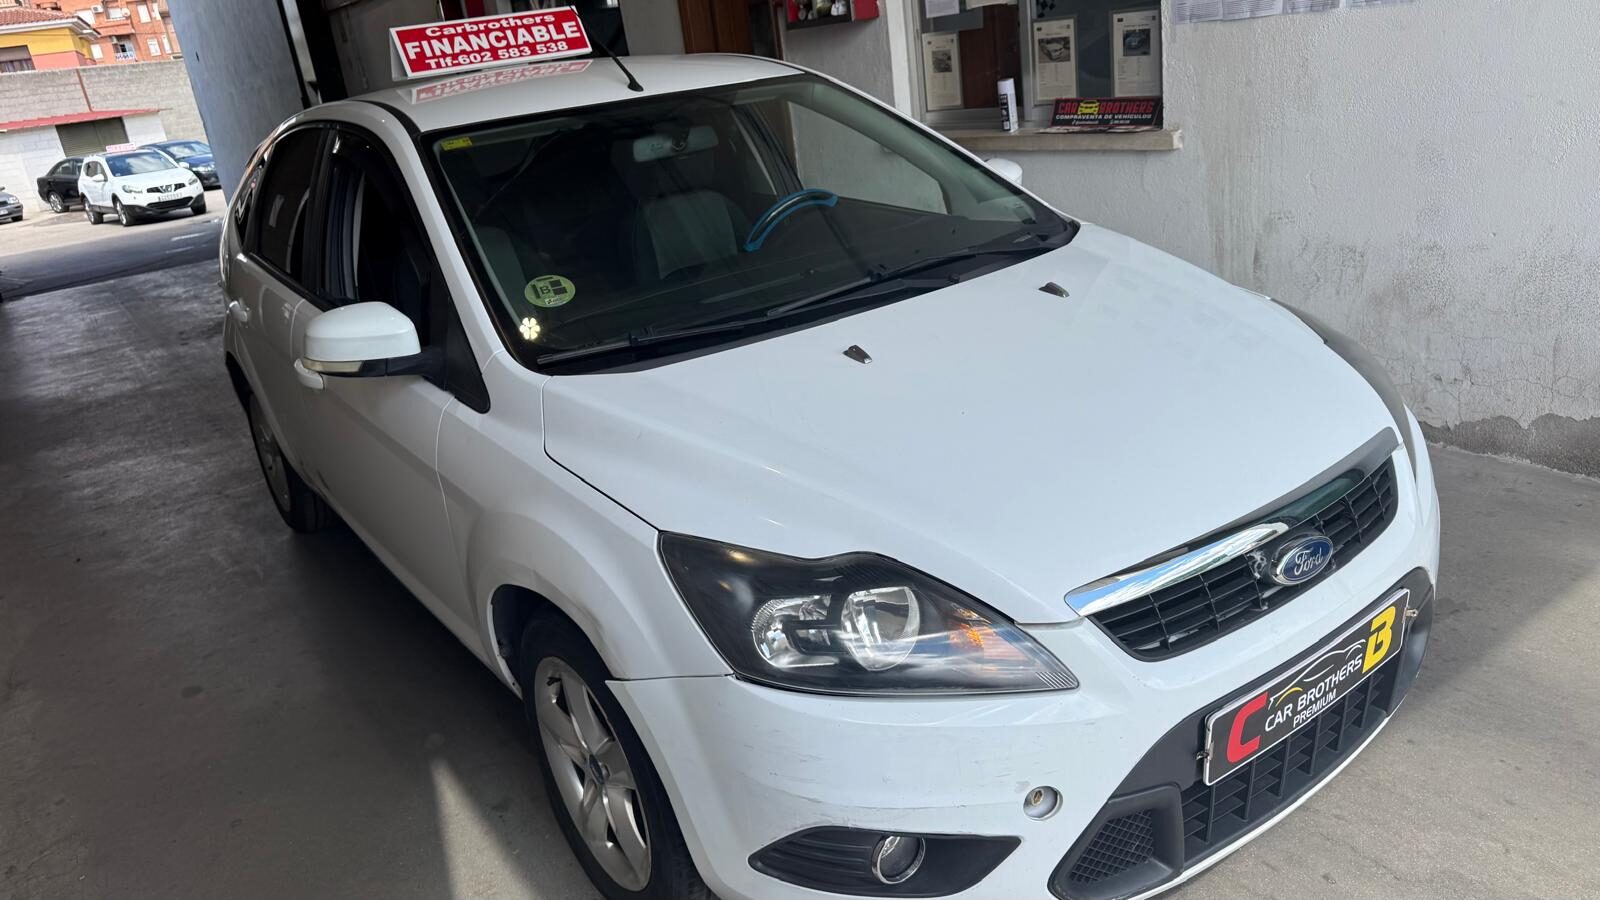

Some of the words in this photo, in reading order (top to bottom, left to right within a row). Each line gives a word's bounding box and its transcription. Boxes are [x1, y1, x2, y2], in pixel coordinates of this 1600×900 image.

[404, 21, 581, 60] FINANCIABLE
[425, 15, 556, 37] Carbrothers
[425, 50, 494, 69] Tlf-602
[497, 46, 532, 60] 583
[535, 41, 569, 54] 538
[1058, 102, 1078, 113] CAR
[1099, 101, 1153, 113] BROTHERS
[539, 285, 551, 295] B
[1294, 546, 1324, 576] Ford
[1226, 691, 1268, 763] C
[1265, 702, 1293, 732] CAR
[1296, 653, 1363, 712] BROTHERS
[1293, 688, 1337, 728] PREMIUM
